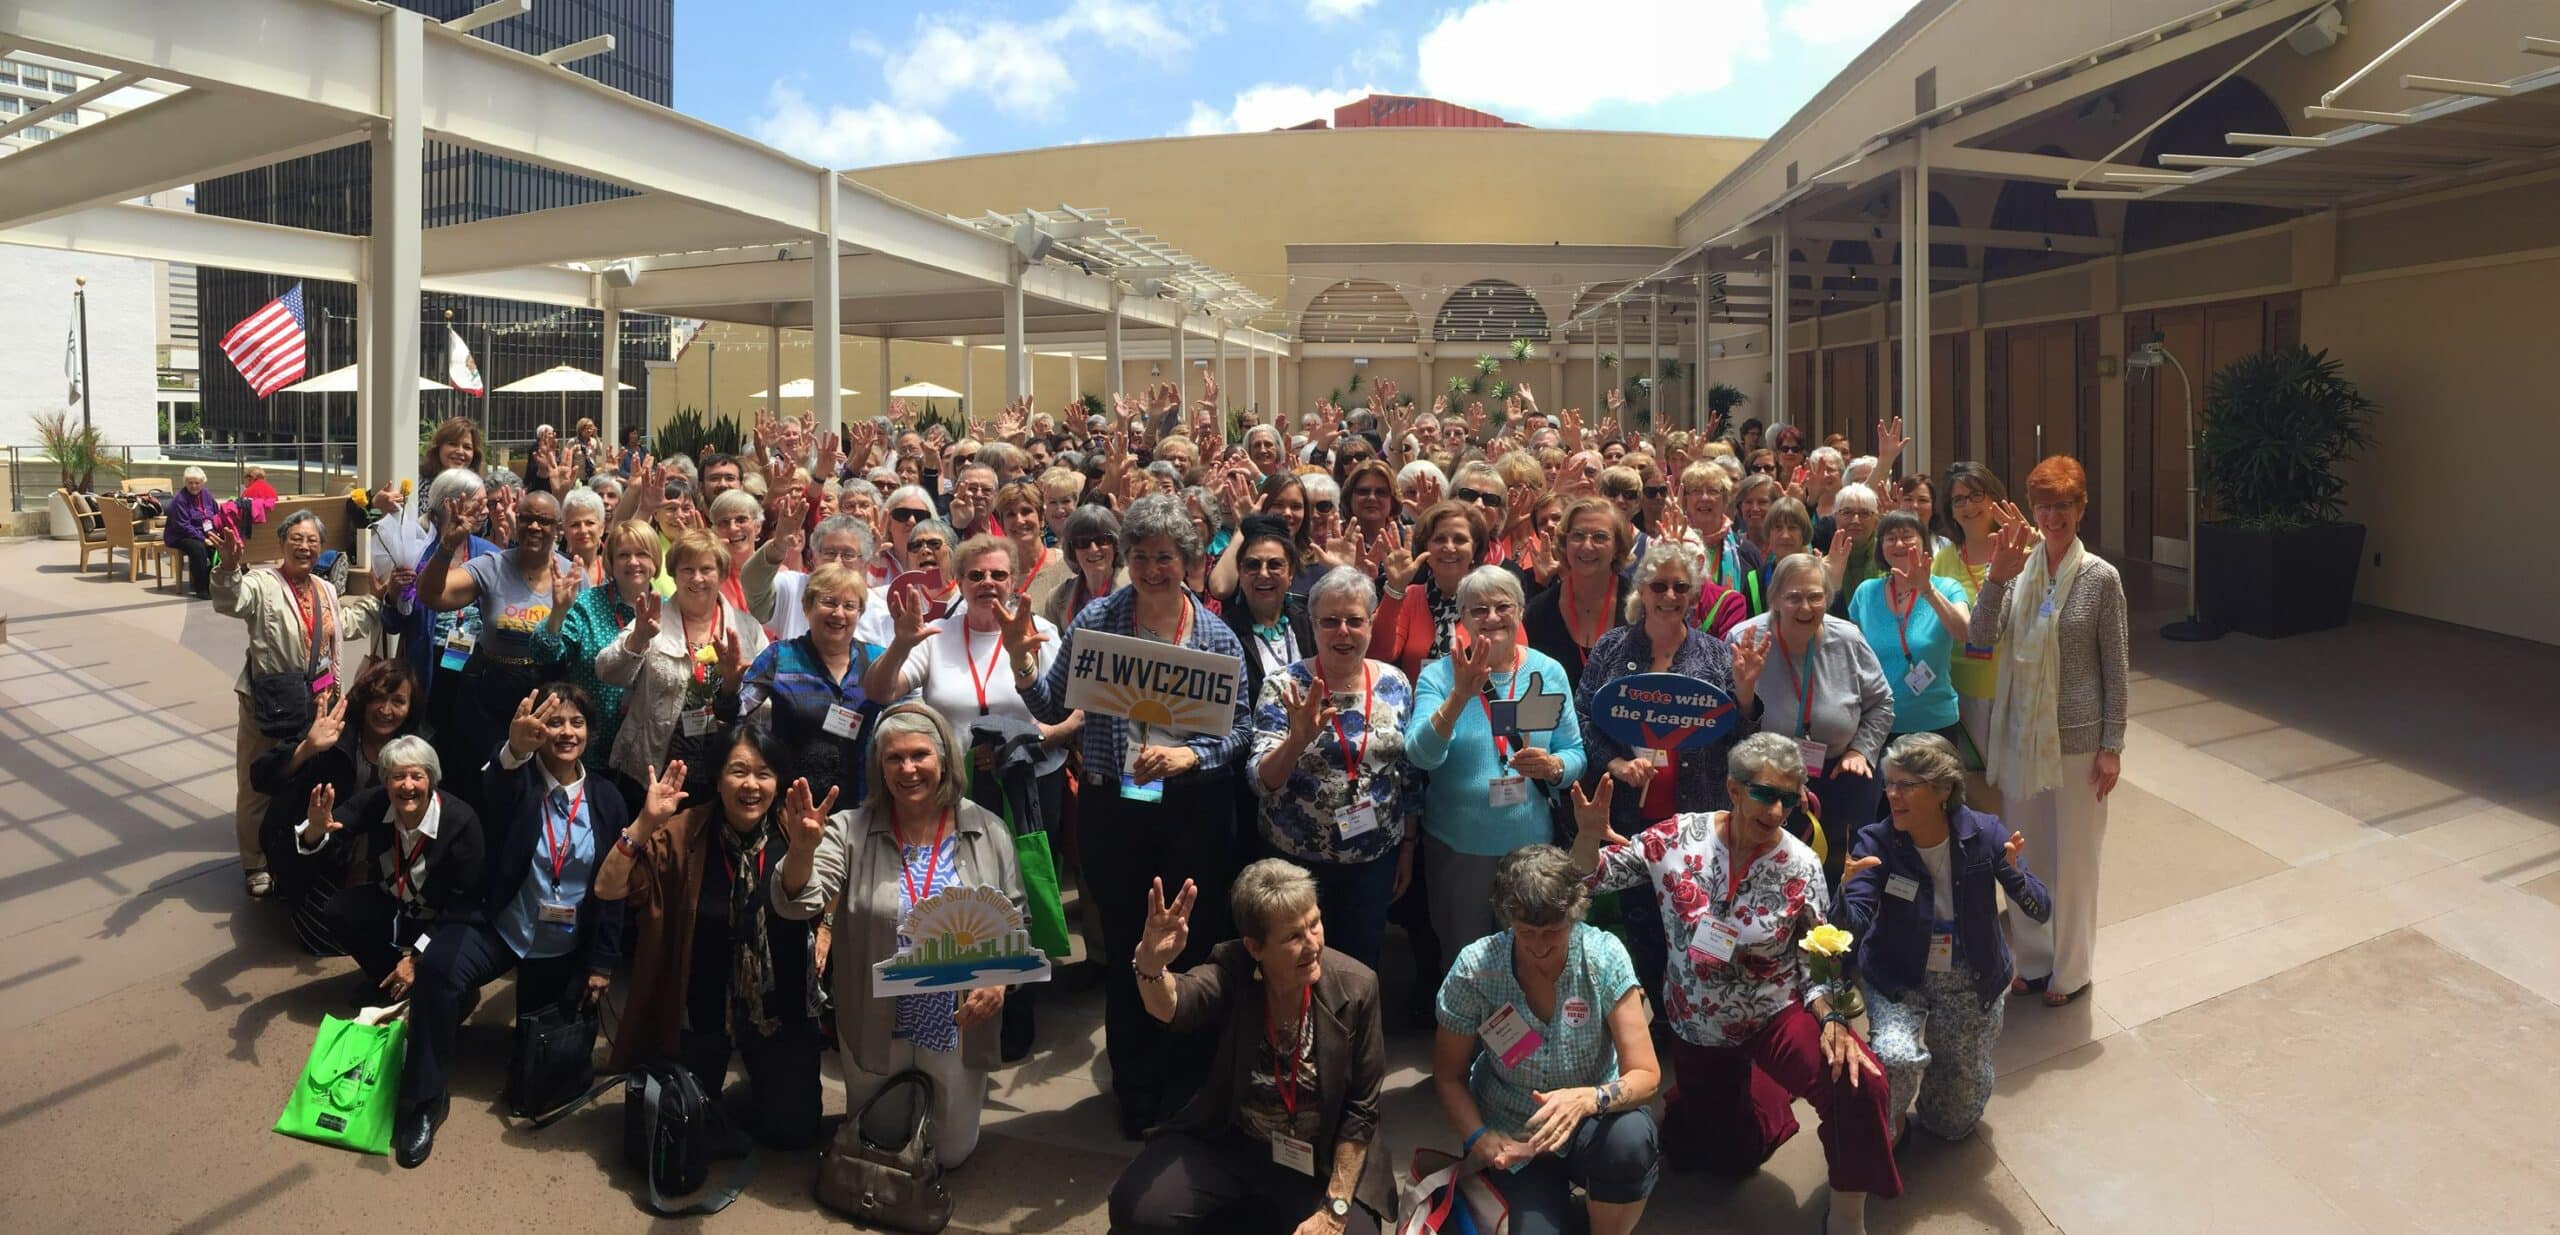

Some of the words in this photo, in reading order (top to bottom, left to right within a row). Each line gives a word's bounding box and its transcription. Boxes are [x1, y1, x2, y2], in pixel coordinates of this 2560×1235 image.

[504, 604, 545, 621] OAK
[1074, 649, 1234, 705] #LWVC2015
[1618, 685, 1628, 698] I
[1628, 689, 1672, 704] vote
[1675, 693, 1718, 708] with
[1611, 705, 1641, 720] the
[1645, 709, 1717, 729] League
[900, 914, 920, 936] Let
[945, 887, 972, 902] Sun
[976, 886, 1010, 913] Shine
